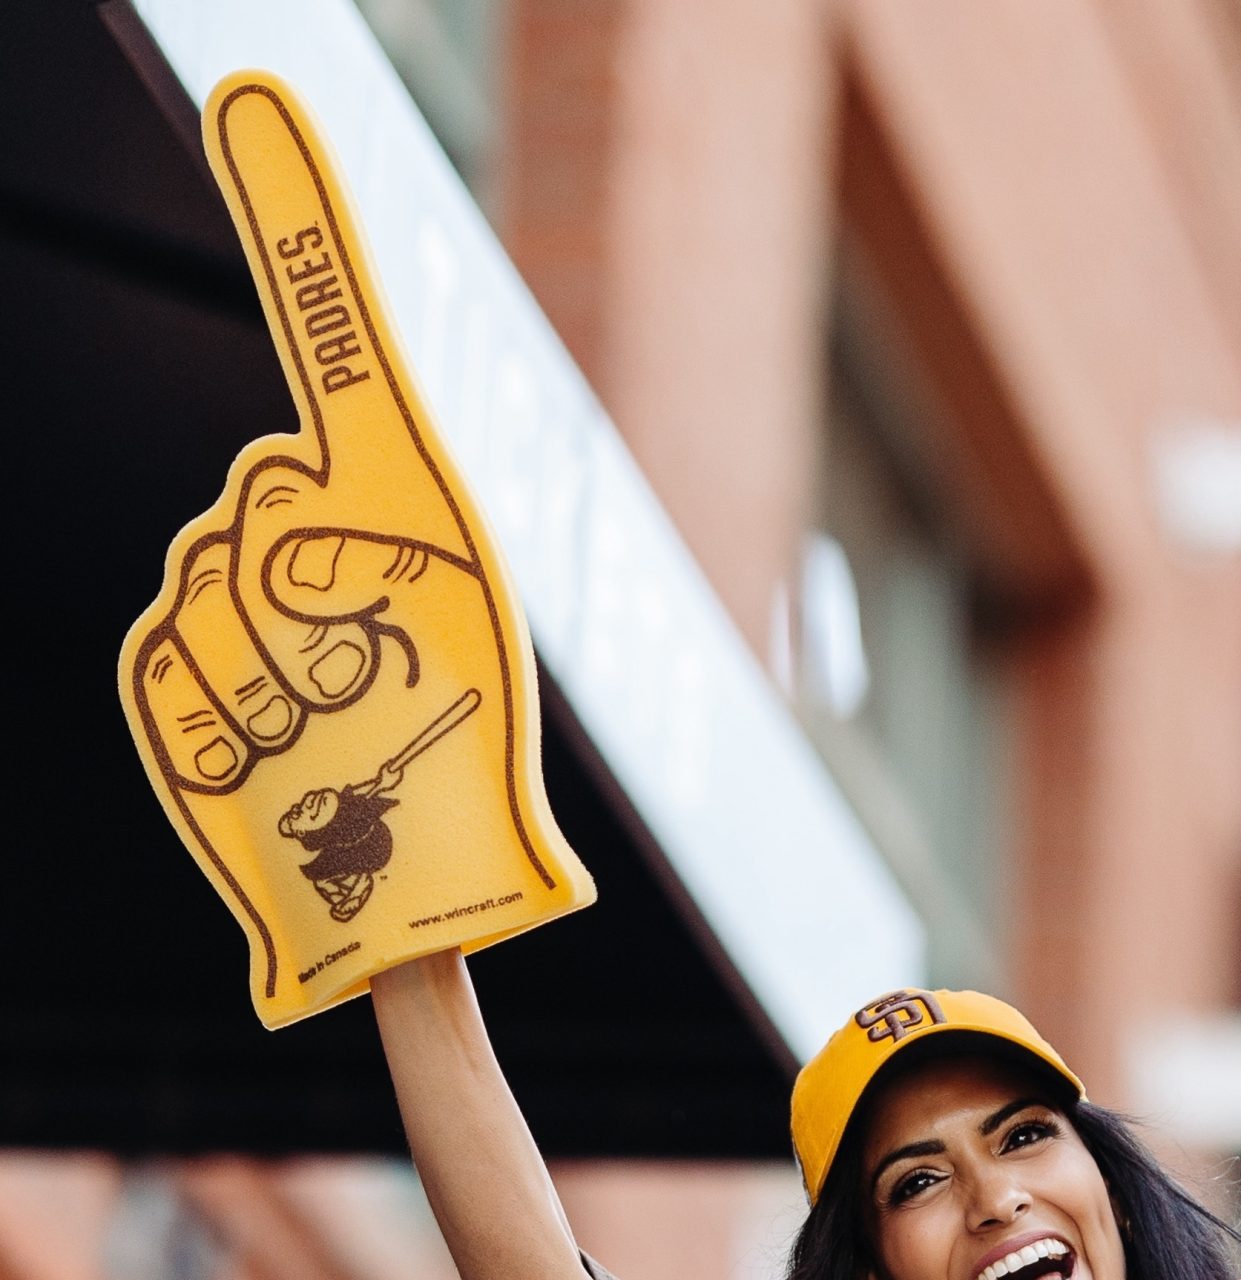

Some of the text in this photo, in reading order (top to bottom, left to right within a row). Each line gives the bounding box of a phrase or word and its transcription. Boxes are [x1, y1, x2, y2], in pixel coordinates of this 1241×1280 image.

[276, 225, 371, 395] PADRES
[408, 891, 523, 929] www.wincraft.com
[298, 967, 316, 984] Made
[325, 941, 361, 966] Canada
